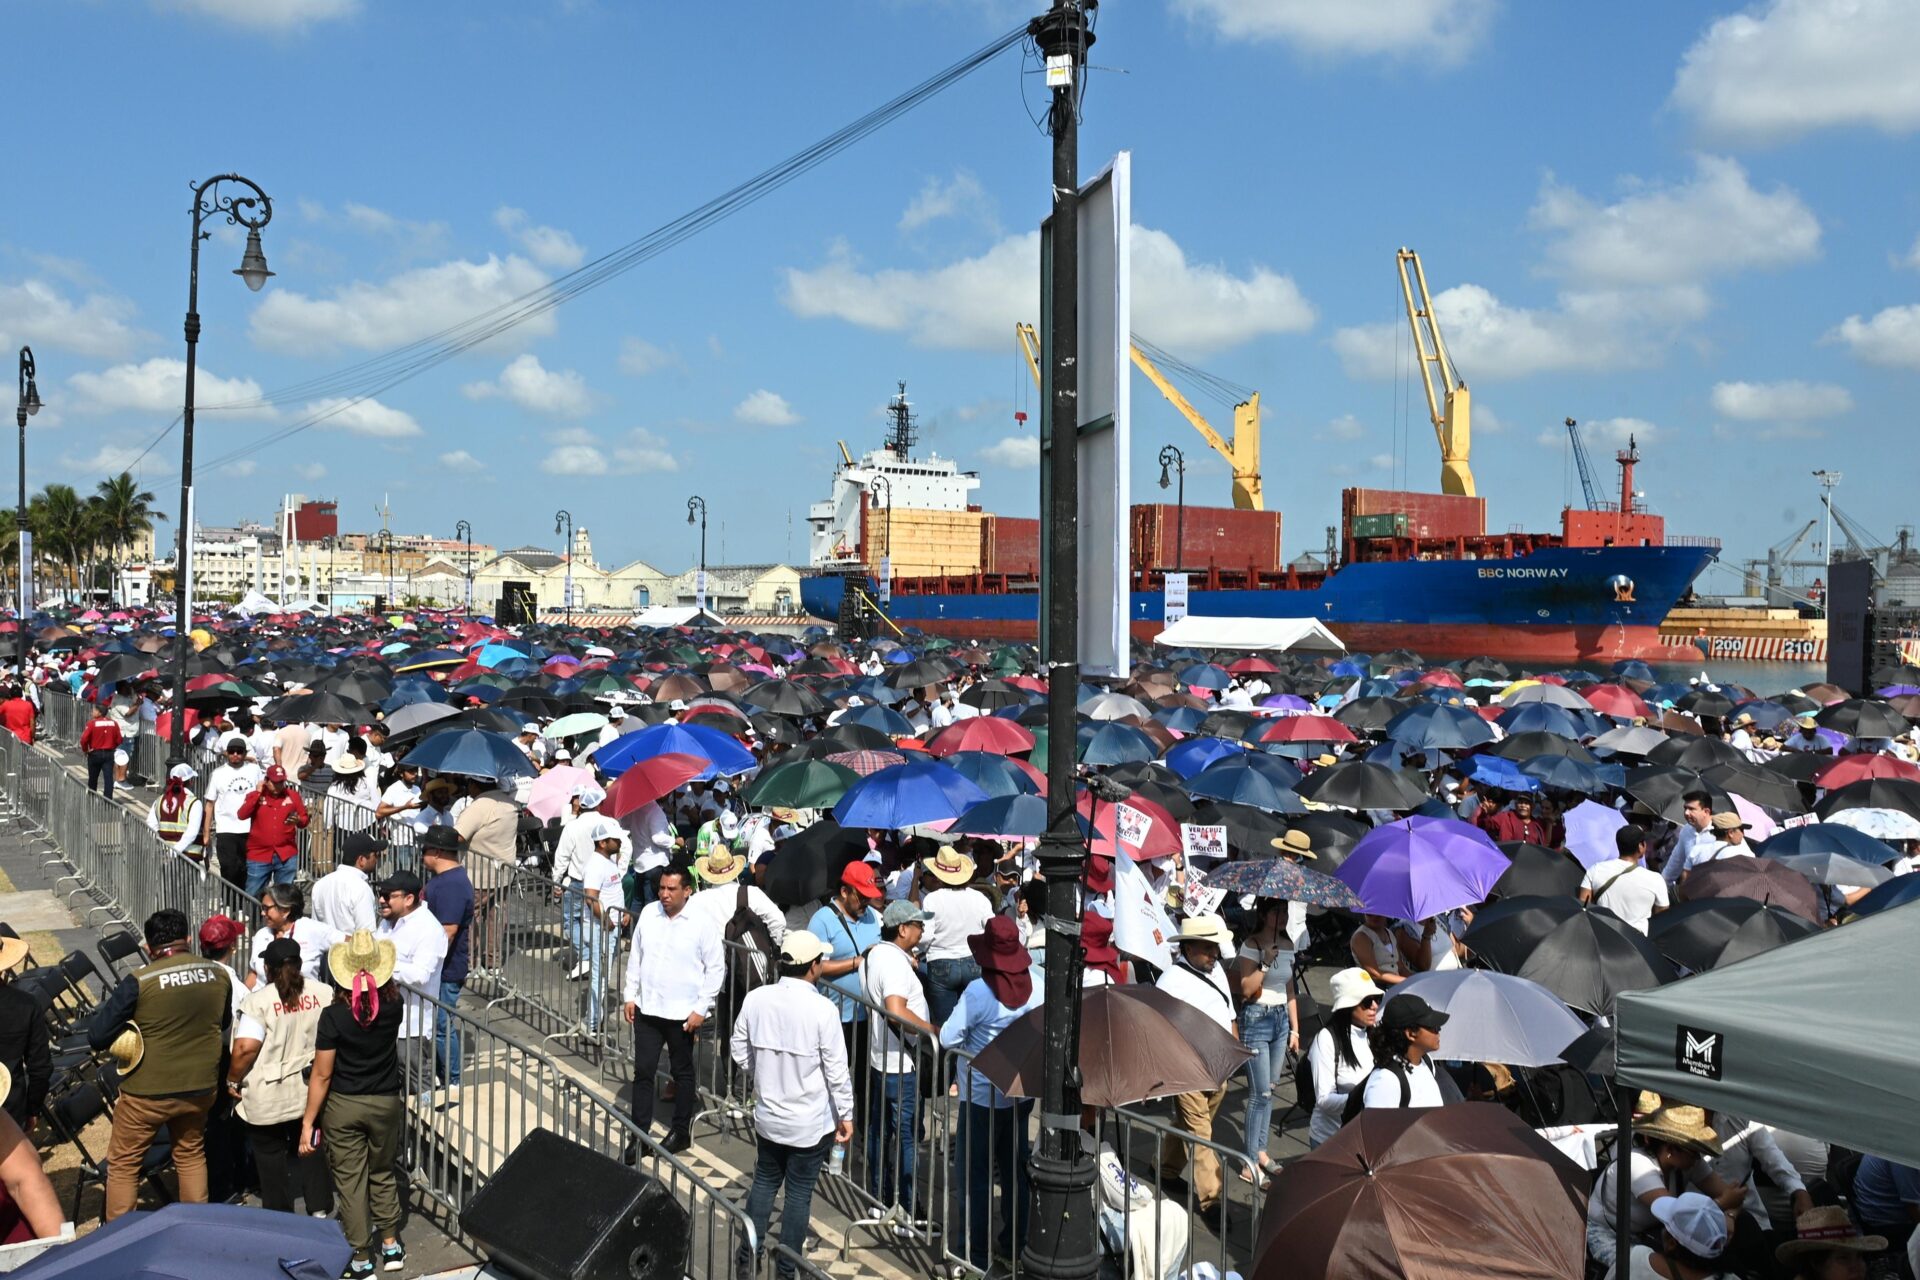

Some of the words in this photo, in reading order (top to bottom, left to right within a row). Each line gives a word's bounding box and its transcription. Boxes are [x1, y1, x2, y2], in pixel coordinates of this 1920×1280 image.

[1477, 568, 1504, 578] BBC
[1506, 568, 1568, 578] NORWAY
[1715, 640, 1742, 651] 200
[1785, 642, 1813, 653] 210
[1190, 844, 1223, 852] morena
[158, 968, 217, 990] PRENSA
[1682, 1057, 1716, 1071] Member's
